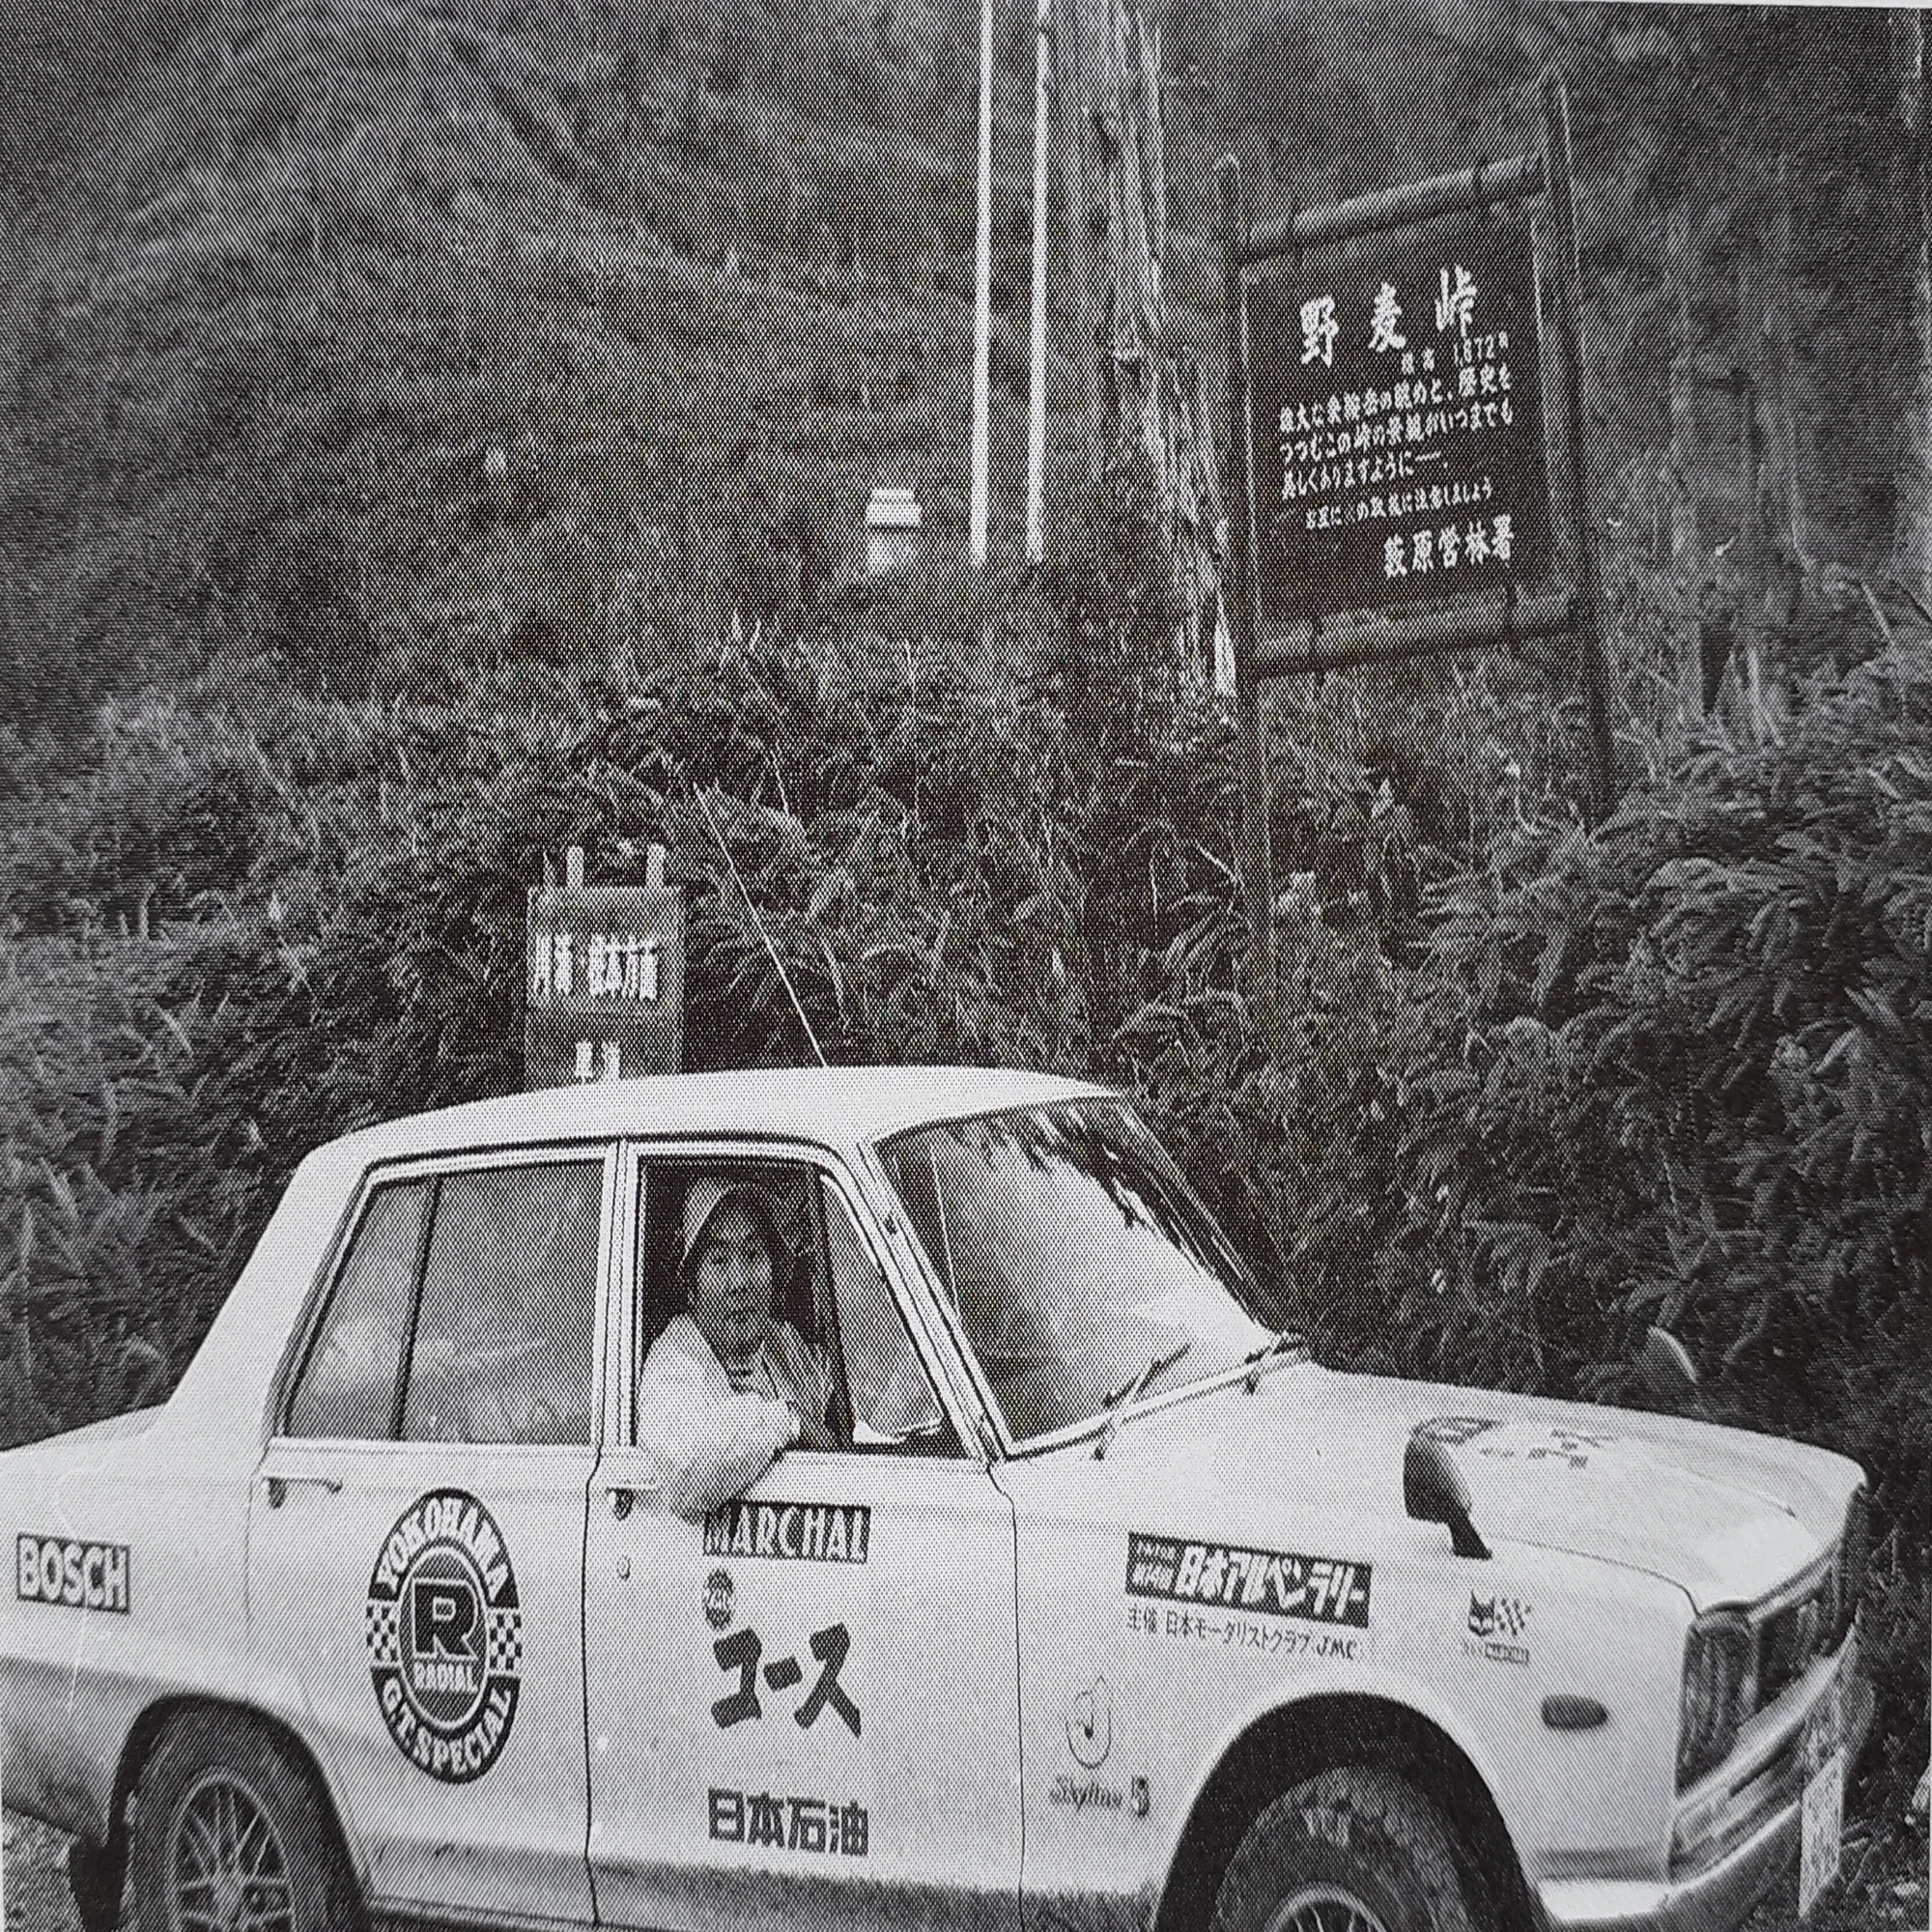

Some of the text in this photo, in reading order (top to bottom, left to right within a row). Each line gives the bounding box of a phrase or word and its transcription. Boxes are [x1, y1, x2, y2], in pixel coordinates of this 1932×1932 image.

[1300, 265, 1477, 368] 野麦峠
[376, 1496, 510, 1602] YOKOHAMA
[705, 1502, 867, 1563] MARCHAL
[18, 1538, 128, 1608] BOSCH
[412, 1577, 479, 1660] R
[412, 1661, 479, 1691] RADIAL
[707, 1787, 869, 1857] 日本石油
